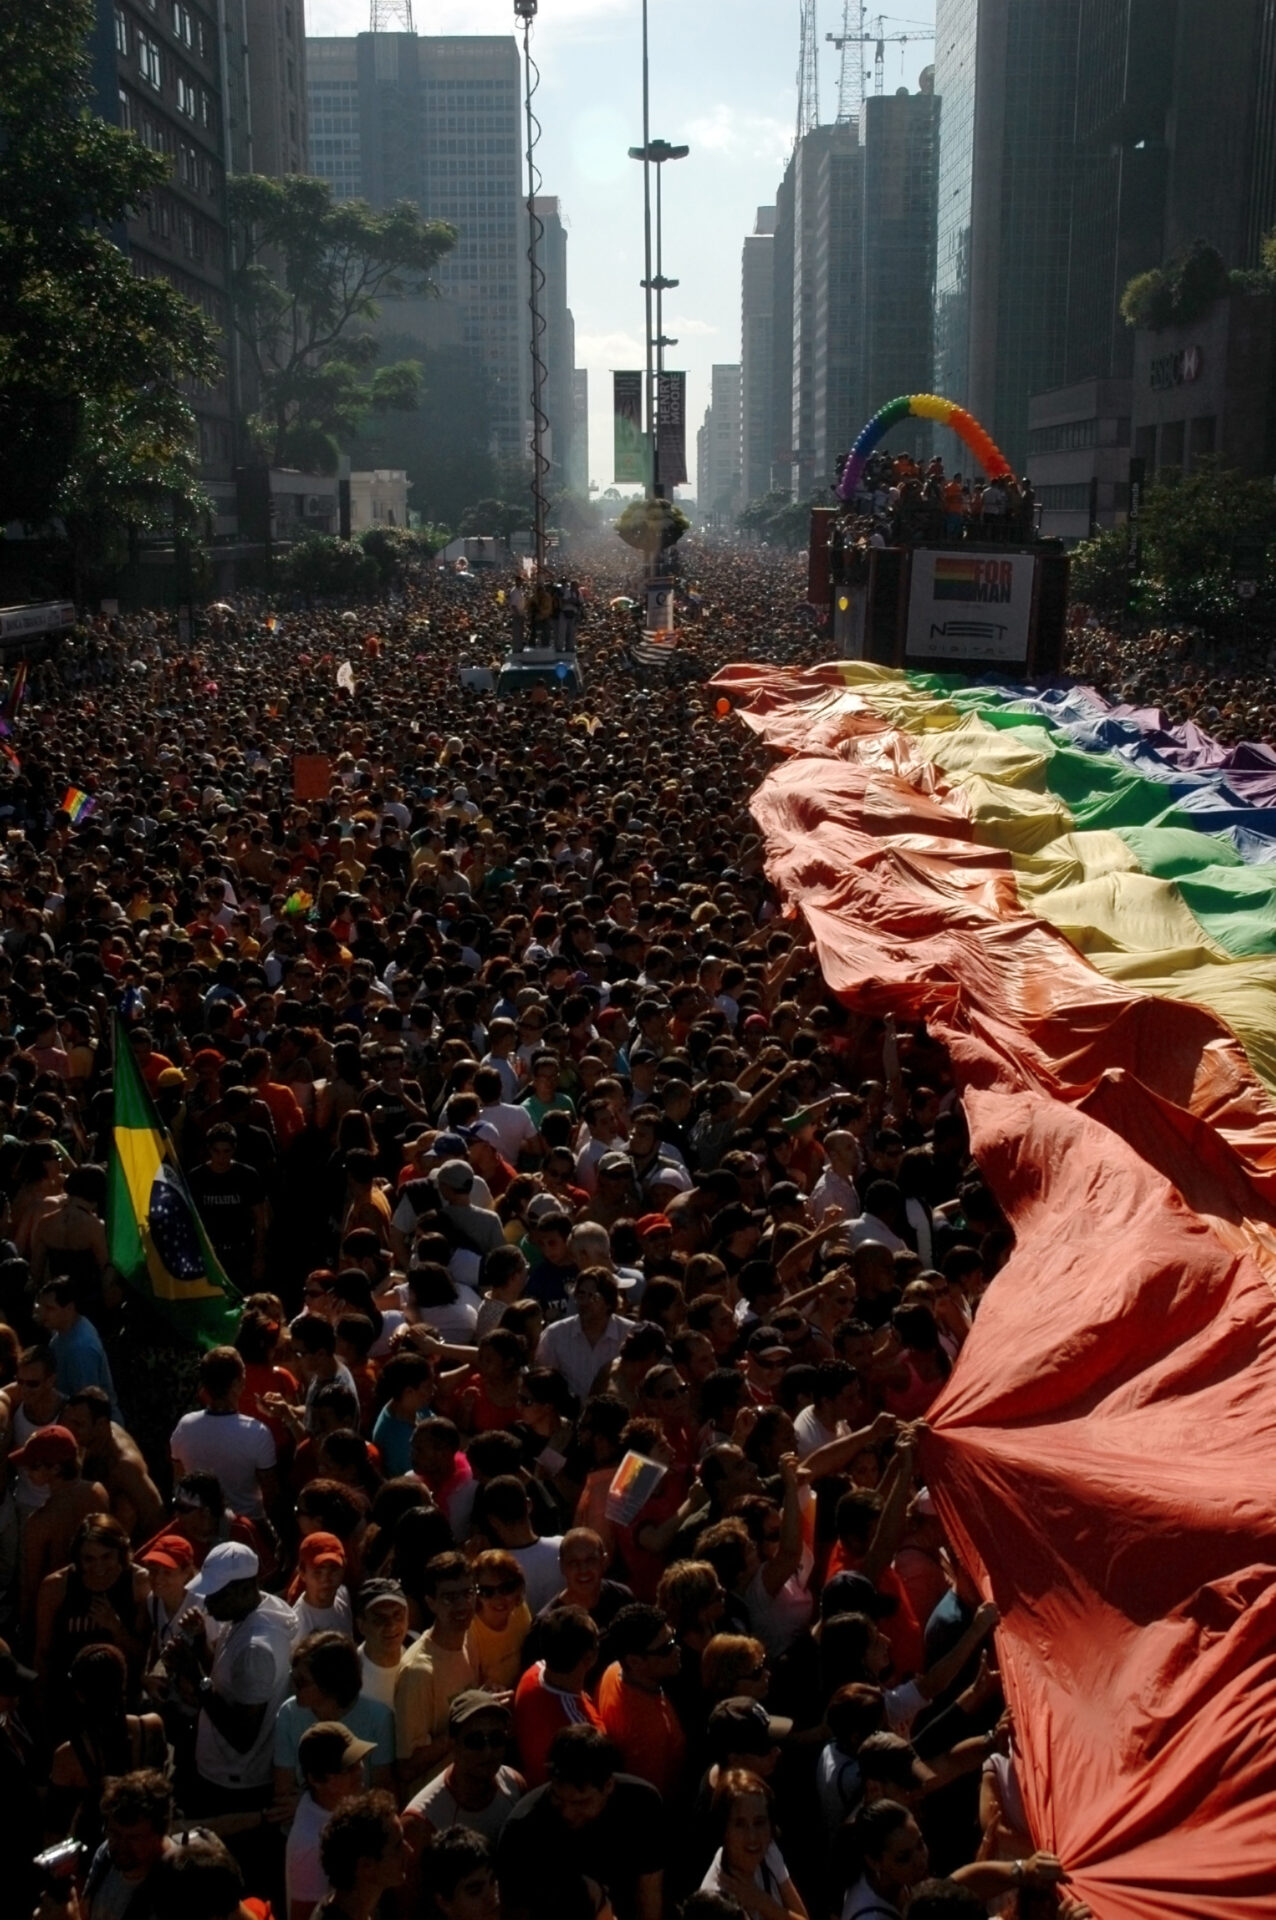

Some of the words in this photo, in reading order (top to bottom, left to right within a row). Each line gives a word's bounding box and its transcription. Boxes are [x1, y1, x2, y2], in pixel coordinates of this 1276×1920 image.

[659, 374, 671, 425] HENRY
[670, 374, 681, 425] MOORE
[975, 559, 1013, 584] FOR
[975, 583, 1011, 603] MAN
[930, 621, 1008, 640] NET
